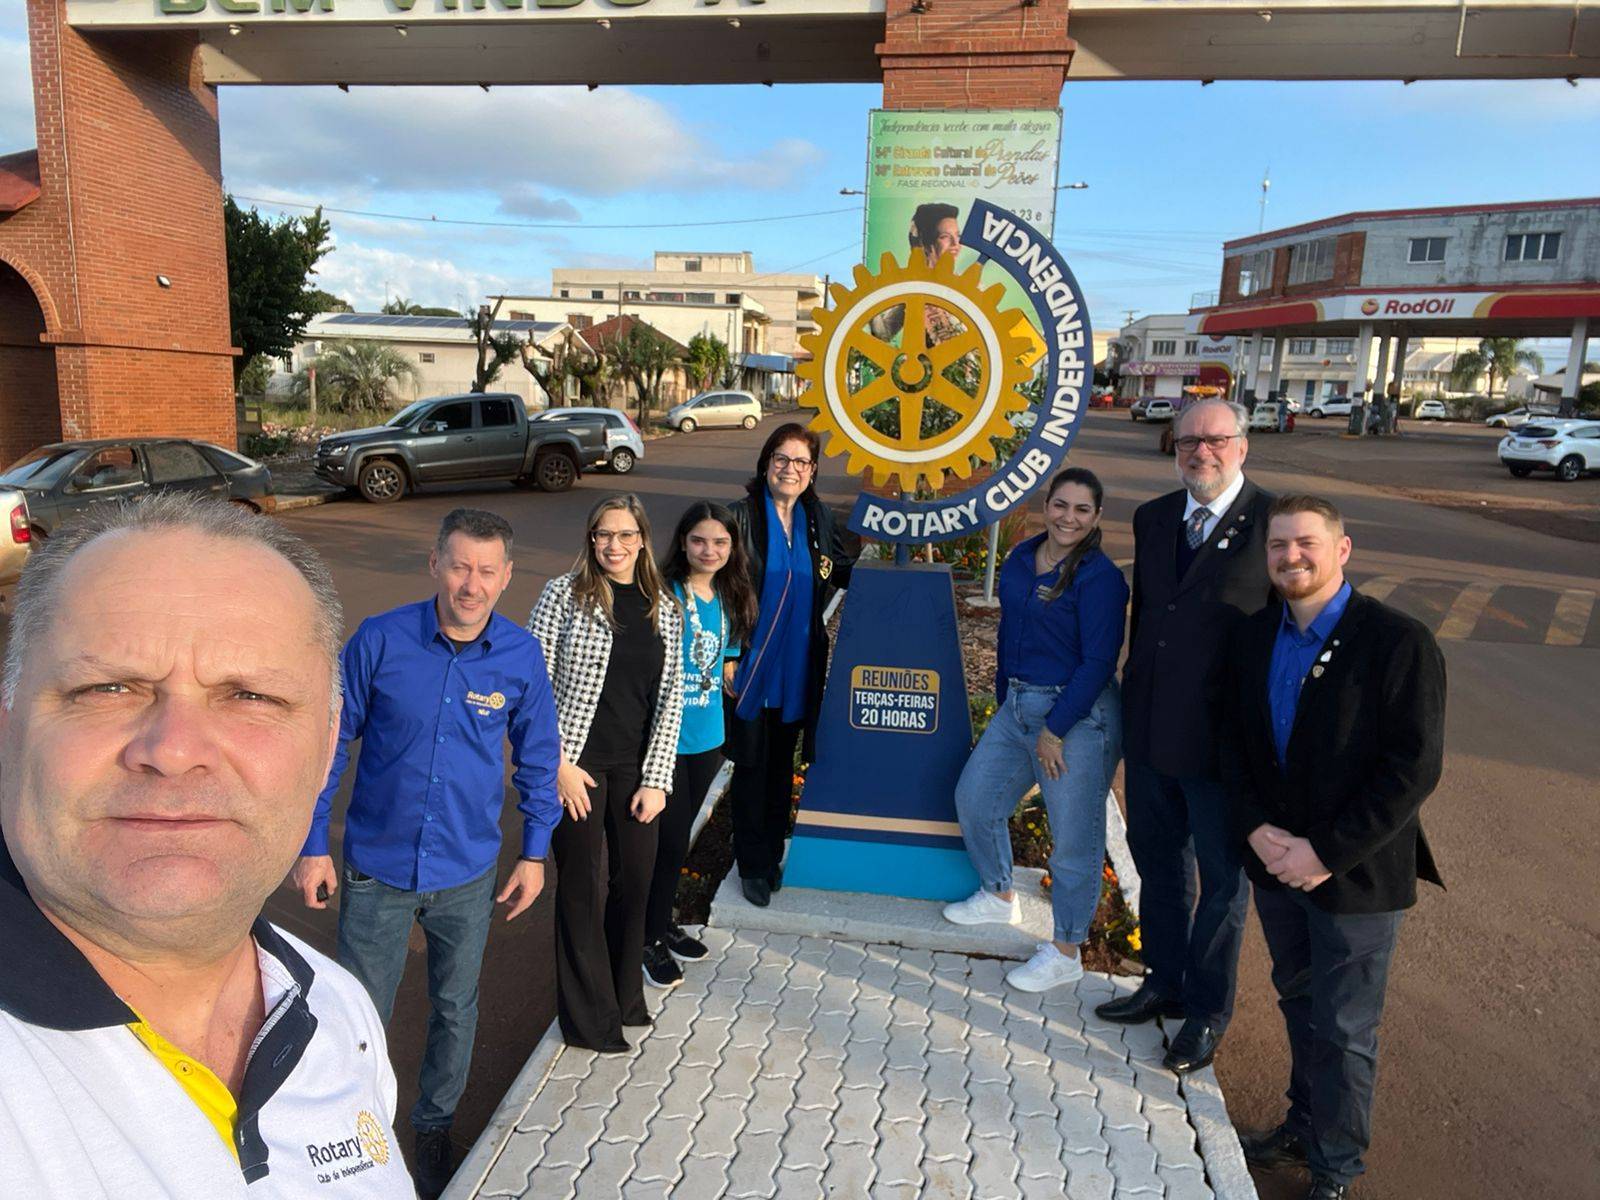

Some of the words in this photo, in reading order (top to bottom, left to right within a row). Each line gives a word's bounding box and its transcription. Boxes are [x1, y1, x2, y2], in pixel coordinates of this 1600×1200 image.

[933, 146, 973, 159] Cultural
[972, 139, 1050, 166] Prendas
[943, 164, 981, 177] Cultural
[897, 180, 918, 188] FASE
[920, 180, 966, 188] REGIONAL
[1384, 298, 1456, 314] RodOil
[982, 211, 1085, 447] INDEPENDÊNCIA
[985, 448, 1052, 512] CLUB
[862, 498, 979, 537] ROTARY
[862, 670, 929, 690] REUNIÕES
[855, 691, 935, 709] TERÇAS-FEIRAS
[861, 708, 878, 725] 20
[881, 710, 927, 729] HORAS
[306, 1136, 363, 1167] Rotary
